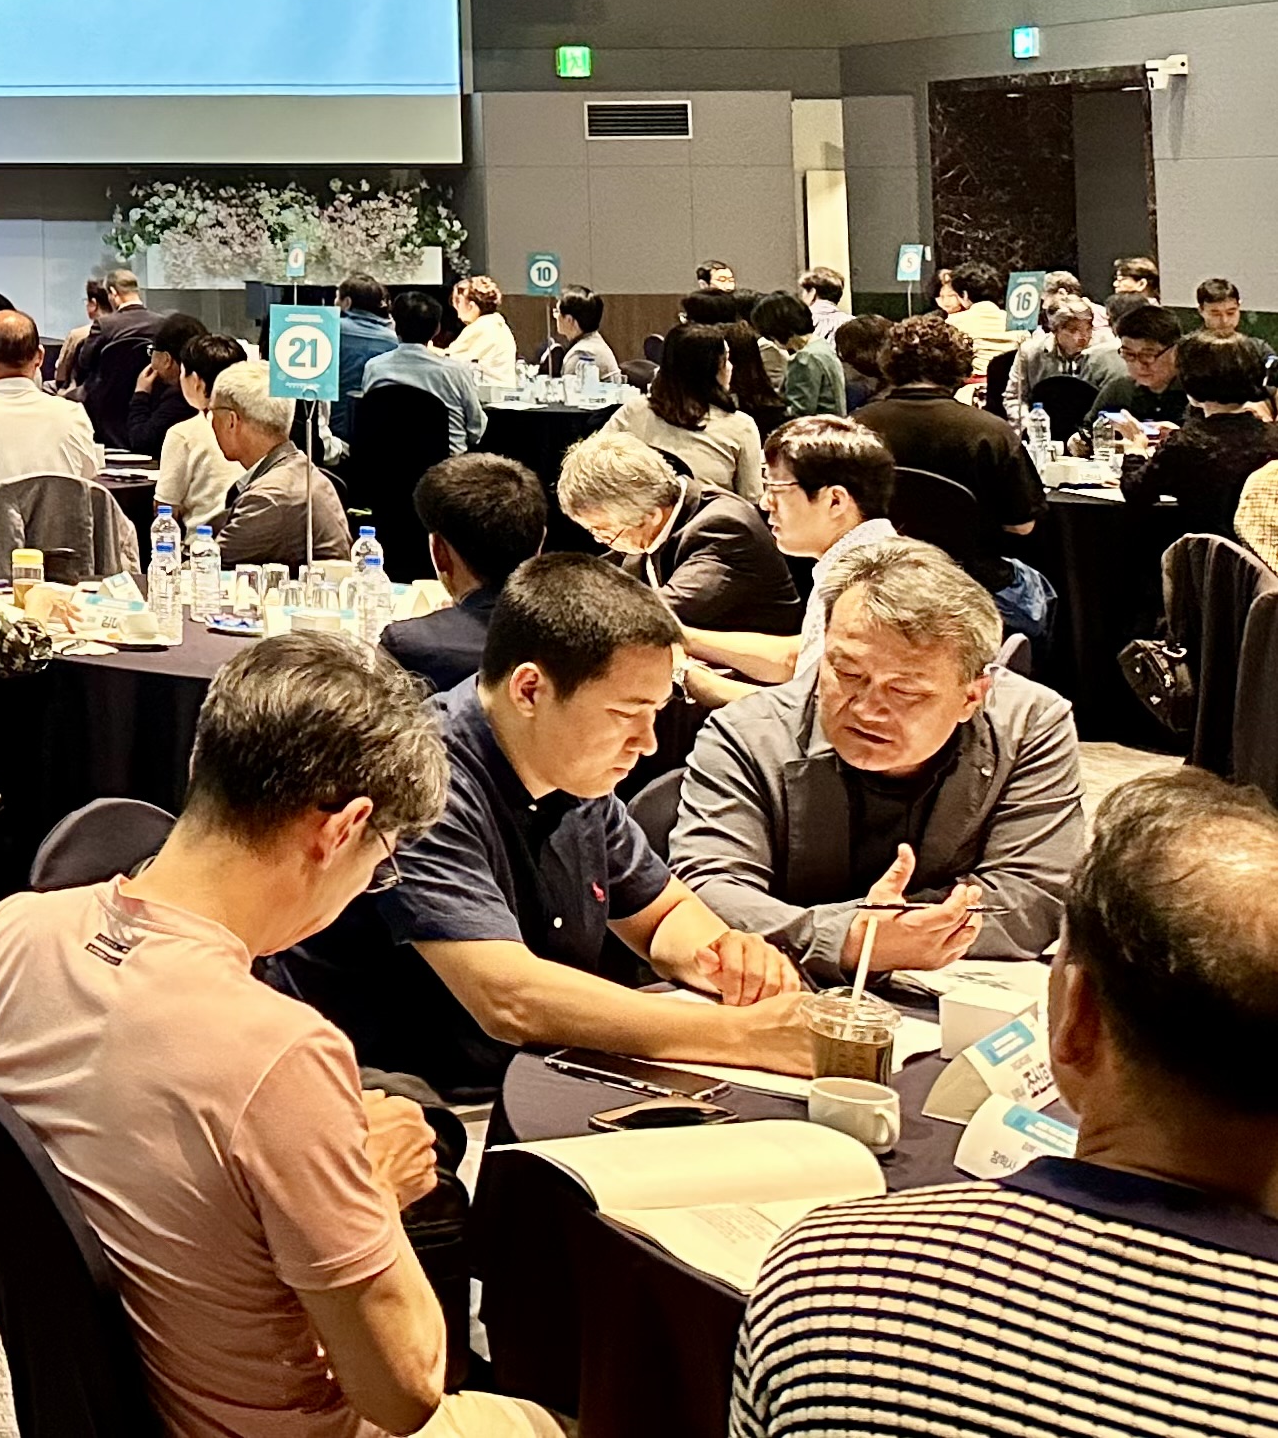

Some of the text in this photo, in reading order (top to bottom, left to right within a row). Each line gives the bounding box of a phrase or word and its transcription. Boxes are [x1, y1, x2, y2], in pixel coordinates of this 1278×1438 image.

[536, 266, 552, 282] 10
[1016, 291, 1032, 312] 16
[288, 337, 318, 369] 21
